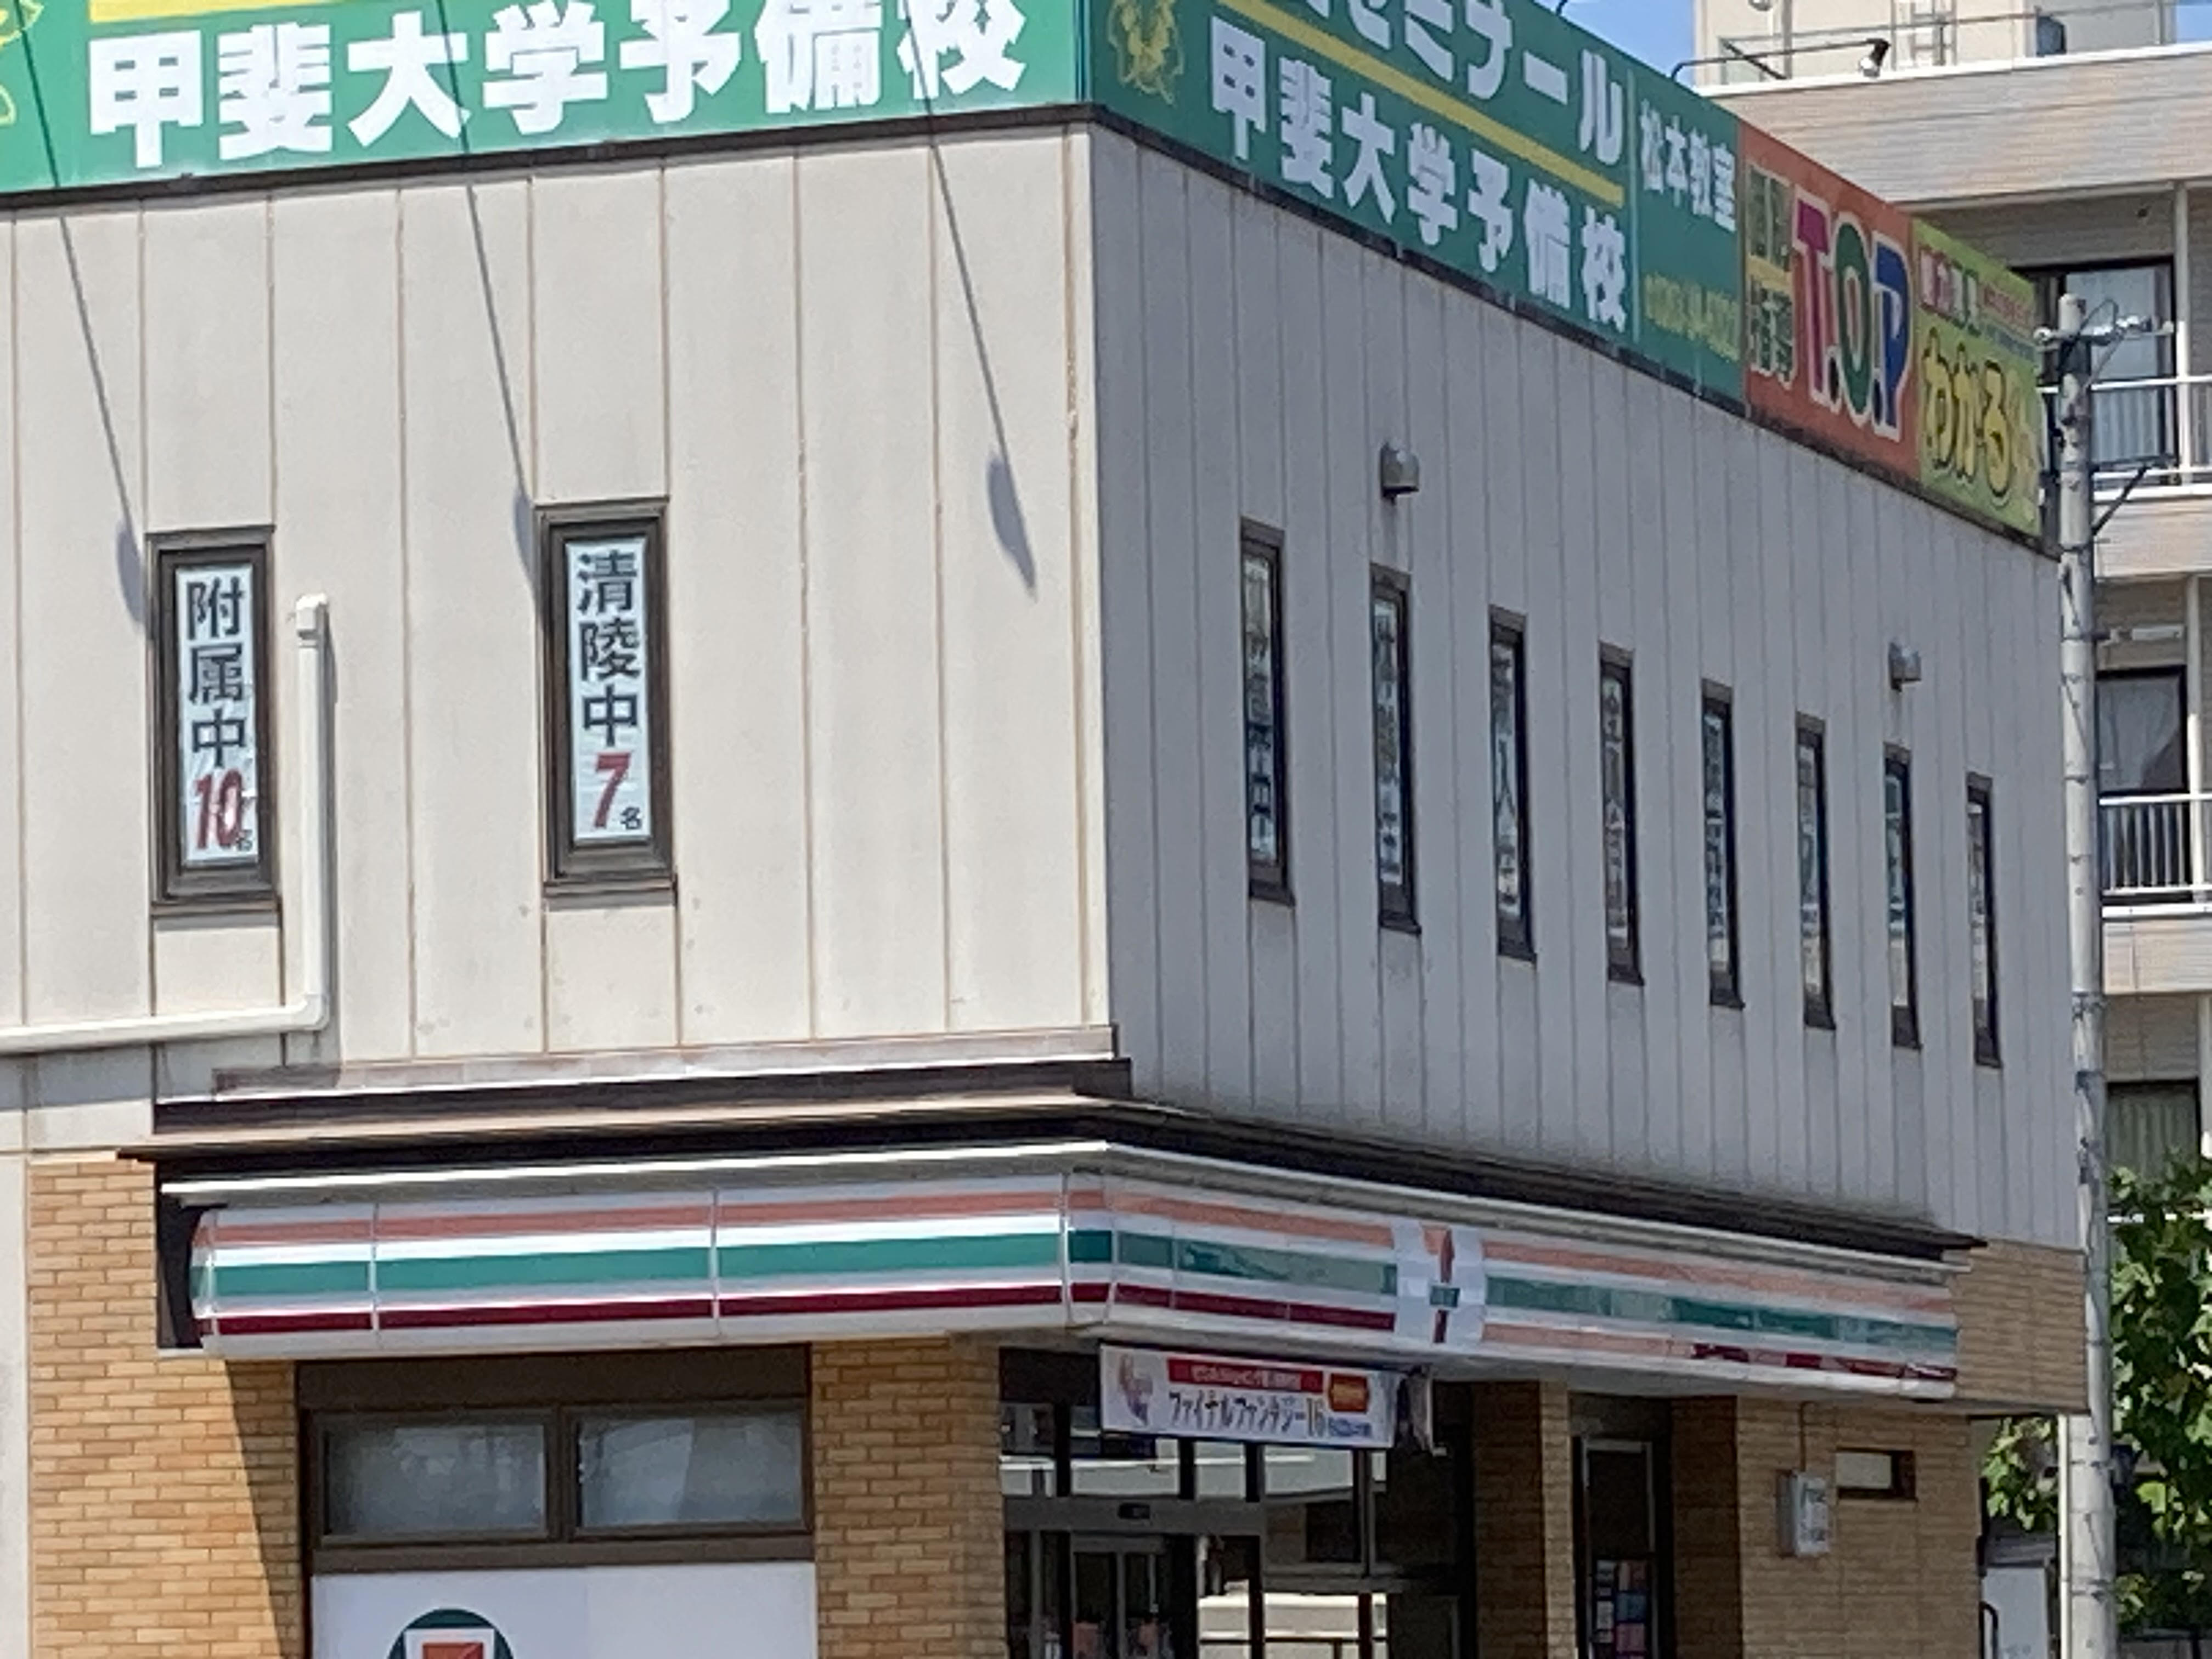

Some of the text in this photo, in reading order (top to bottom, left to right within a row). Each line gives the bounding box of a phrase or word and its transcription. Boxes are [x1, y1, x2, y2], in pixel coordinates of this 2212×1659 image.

[89, 0, 1026, 168] 甲斐大学予備校
[1210, 16, 1627, 332] 甲斐大学予備校
